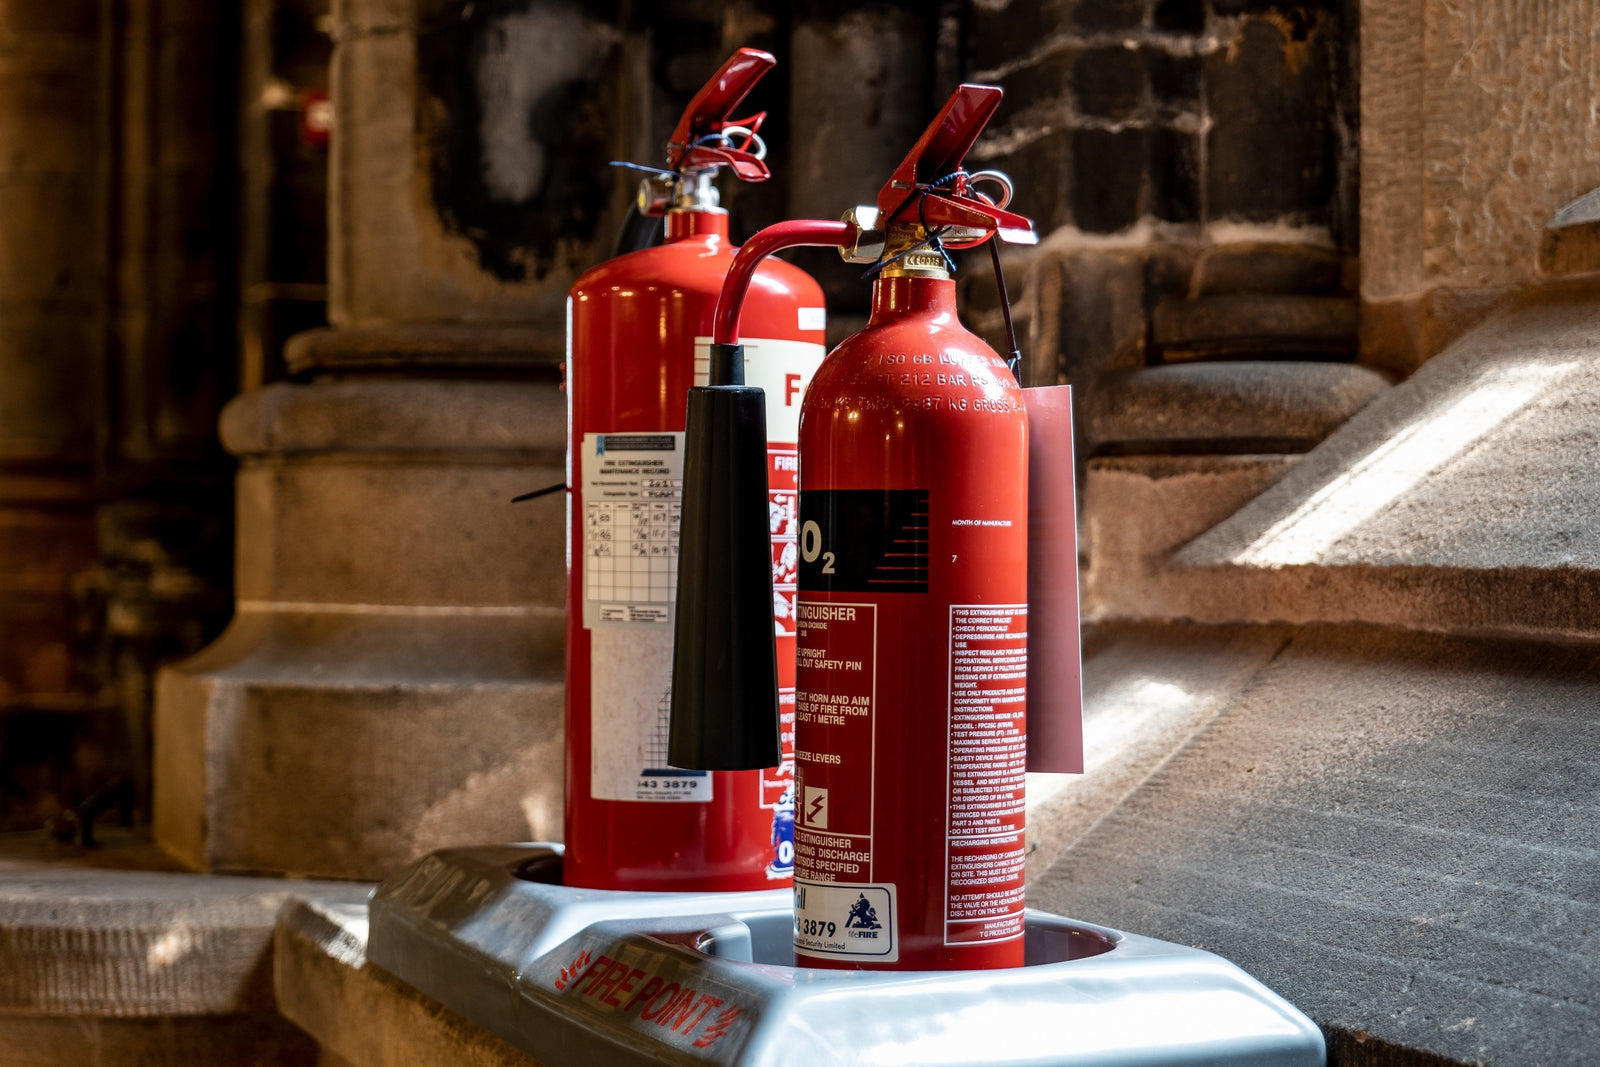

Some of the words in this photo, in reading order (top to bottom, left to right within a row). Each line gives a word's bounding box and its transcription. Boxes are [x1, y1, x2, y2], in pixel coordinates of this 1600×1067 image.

[900, 372, 931, 386] 212
[937, 374, 966, 386] BAR
[973, 398, 1010, 413] GROSS
[952, 554, 957, 563] 7
[802, 649, 826, 658] UPRIGHT
[803, 658, 814, 668] OUT
[814, 660, 844, 670] SAFETY
[846, 661, 862, 670] PIN
[809, 693, 829, 703] HORN
[830, 696, 849, 705] AND
[851, 696, 869, 706] AIM
[810, 704, 819, 713] OF
[820, 704, 838, 714] FIRE
[840, 706, 868, 716] FROM
[813, 714, 816, 723] 1
[818, 714, 845, 725] METRE
[812, 753, 841, 764] LEVERS
[801, 833, 851, 848] EXTINGUISHER
[818, 849, 870, 862] DISCHARGE
[816, 860, 859, 873] SPECIFIED
[951, 862, 993, 870] EXTINGUISHERS
[804, 918, 836, 938] 3879
[806, 939, 822, 949] Security
[824, 941, 845, 950] Limited
[571, 955, 646, 1007] FIRE
[624, 976, 724, 1035] POINT
